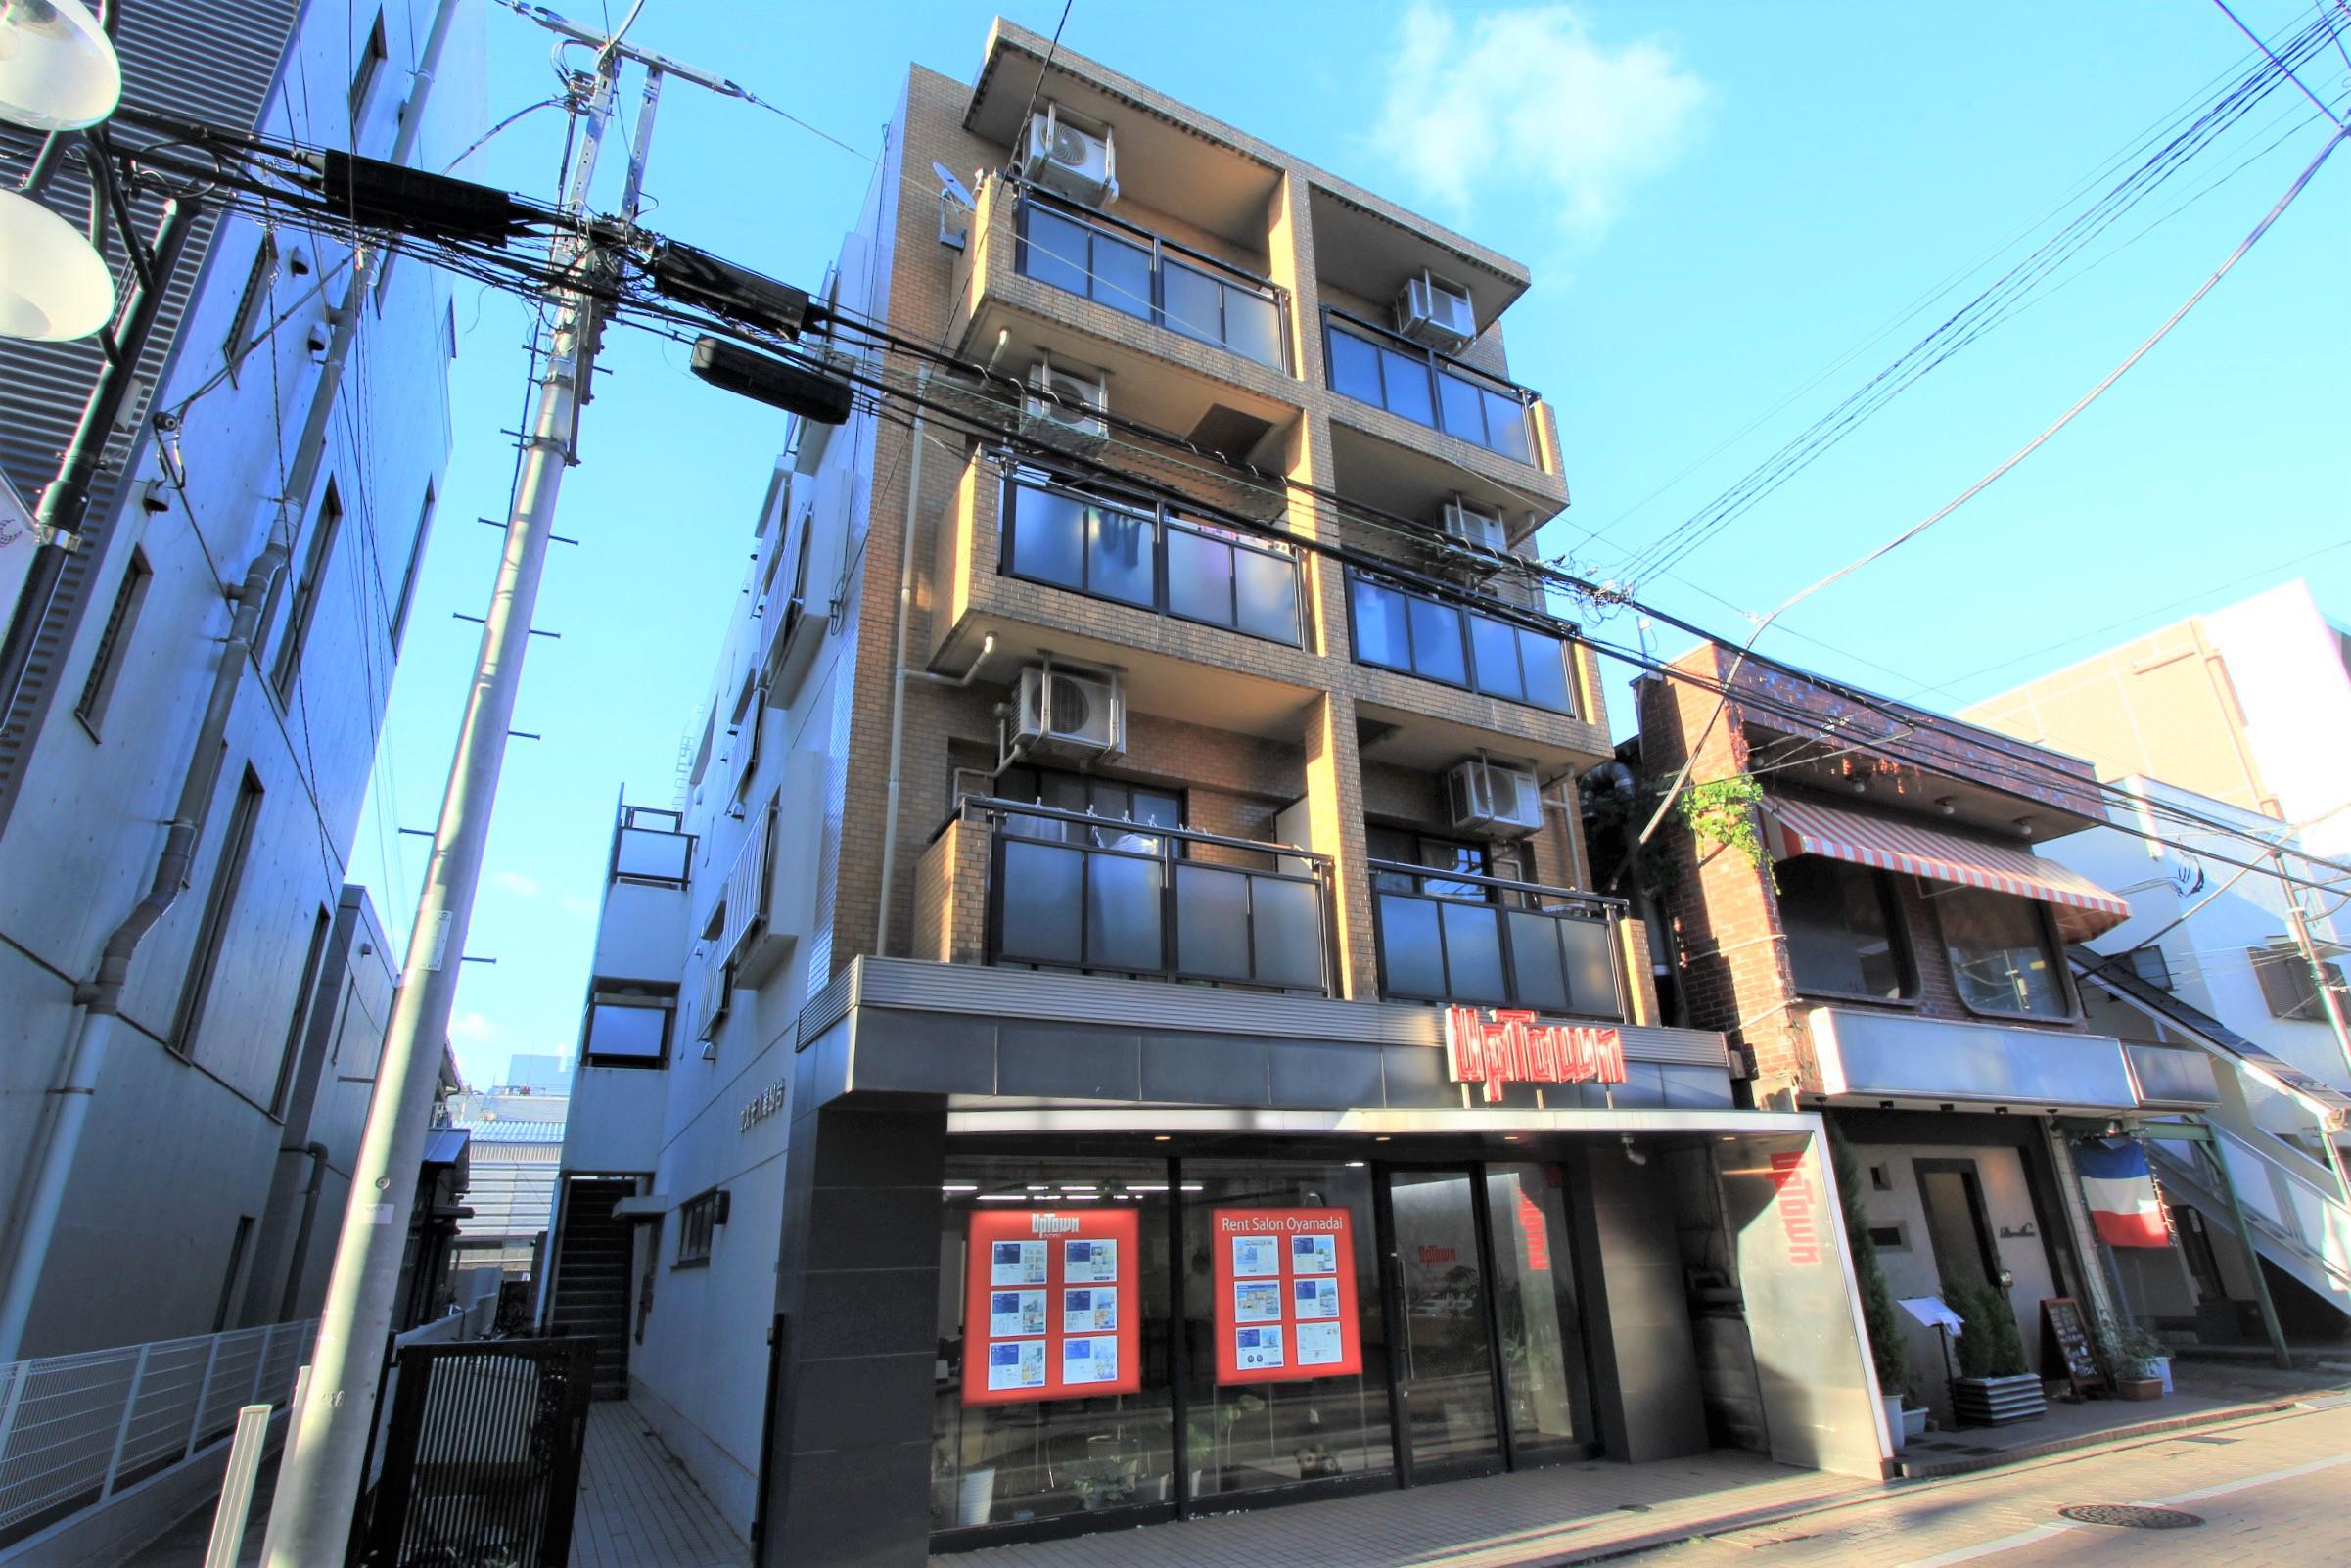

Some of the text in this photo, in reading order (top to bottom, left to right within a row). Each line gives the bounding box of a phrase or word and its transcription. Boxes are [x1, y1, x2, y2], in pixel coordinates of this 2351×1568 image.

[1445, 1004, 1627, 1102] UpTown
[1032, 1213, 1079, 1238] UpTown
[1222, 1217, 1343, 1233] Rent Salon Oyamadai
